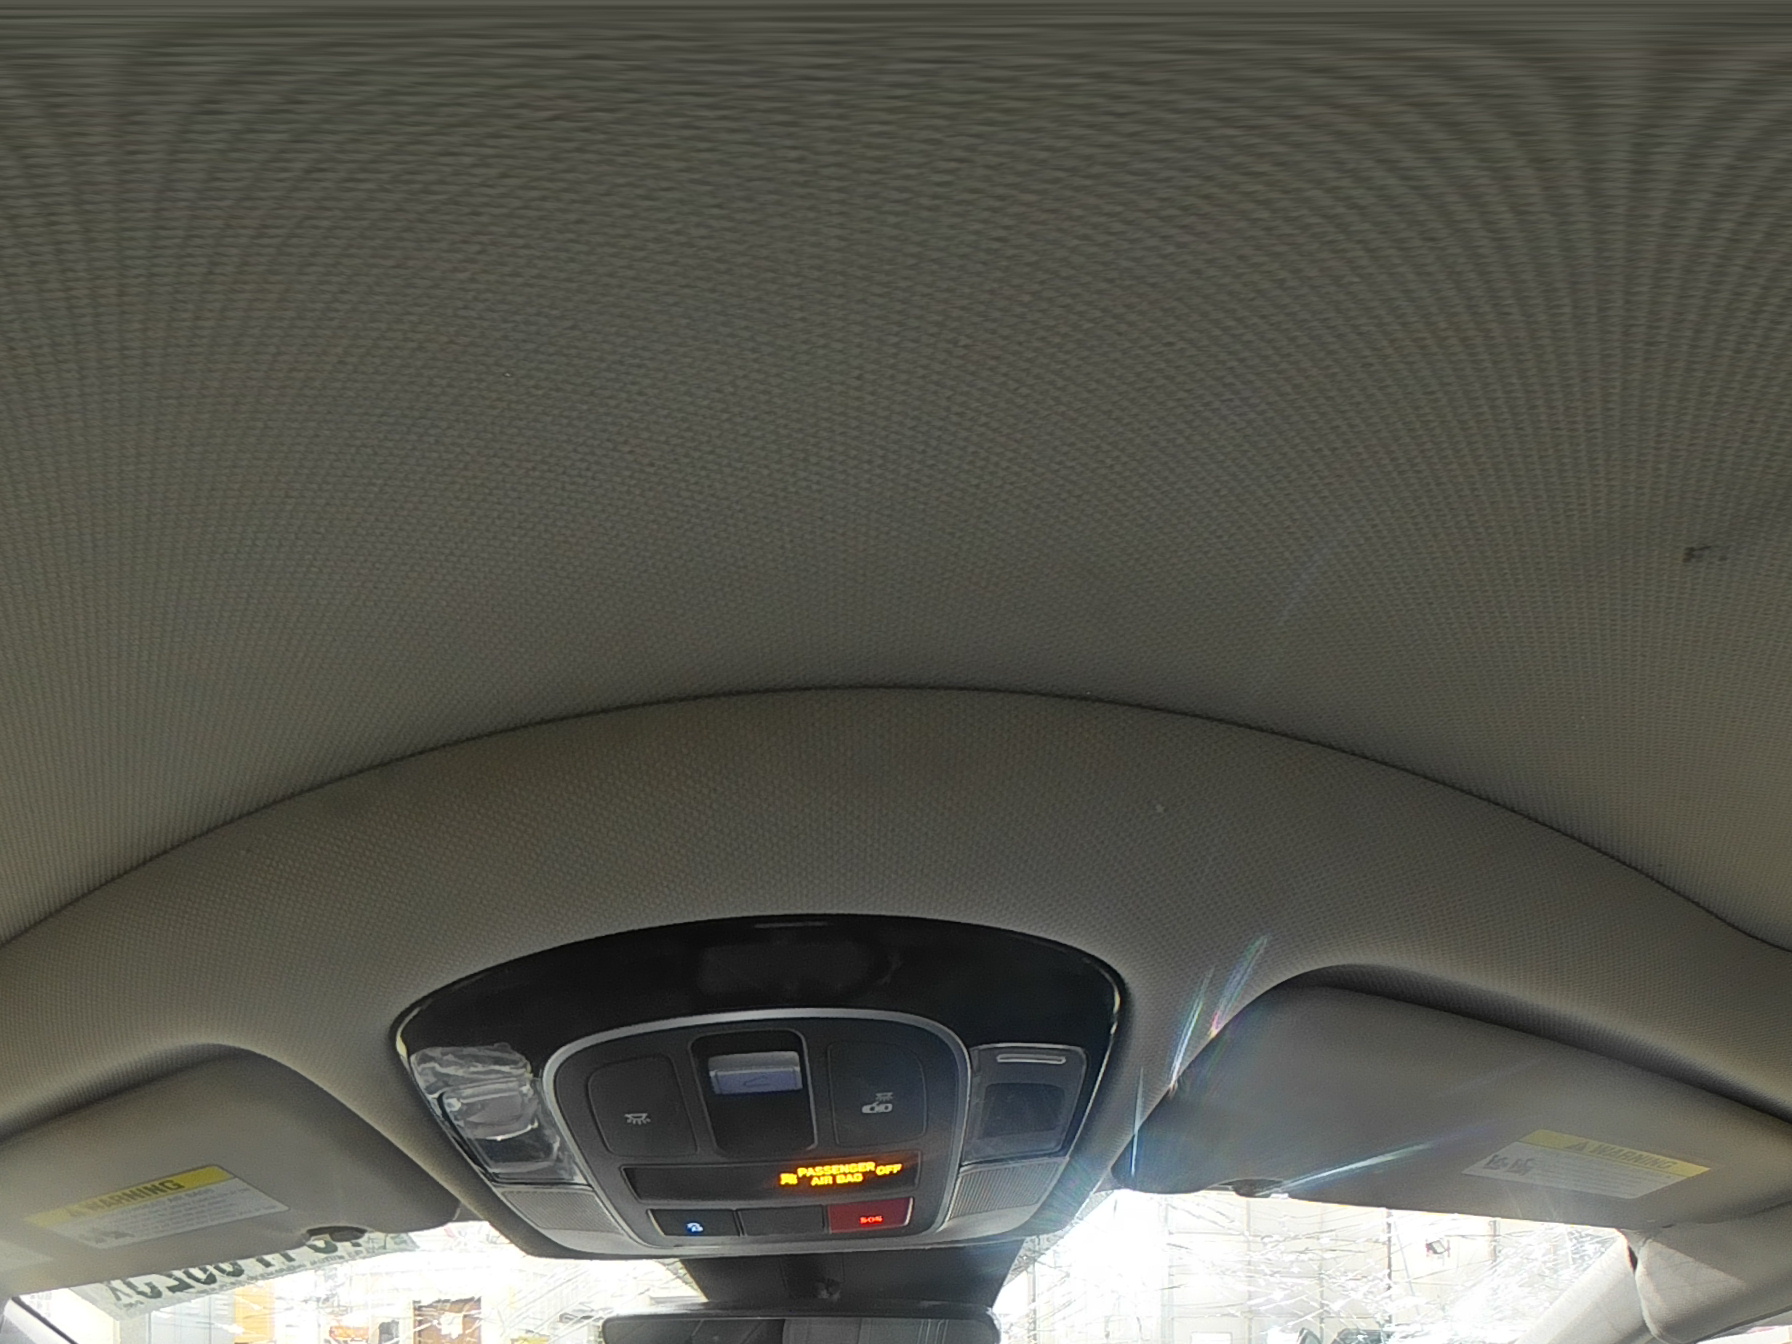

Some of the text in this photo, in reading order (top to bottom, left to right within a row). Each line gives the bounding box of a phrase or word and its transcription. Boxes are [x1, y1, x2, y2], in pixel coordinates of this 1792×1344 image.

[1590, 1143, 1679, 1170] WARNING
[797, 1162, 876, 1178] PASSENGER
[875, 1164, 903, 1176] OFF
[811, 1173, 864, 1186] AIR BAG
[87, 1179, 185, 1213] WARNING
[860, 1216, 883, 1224] SOS
